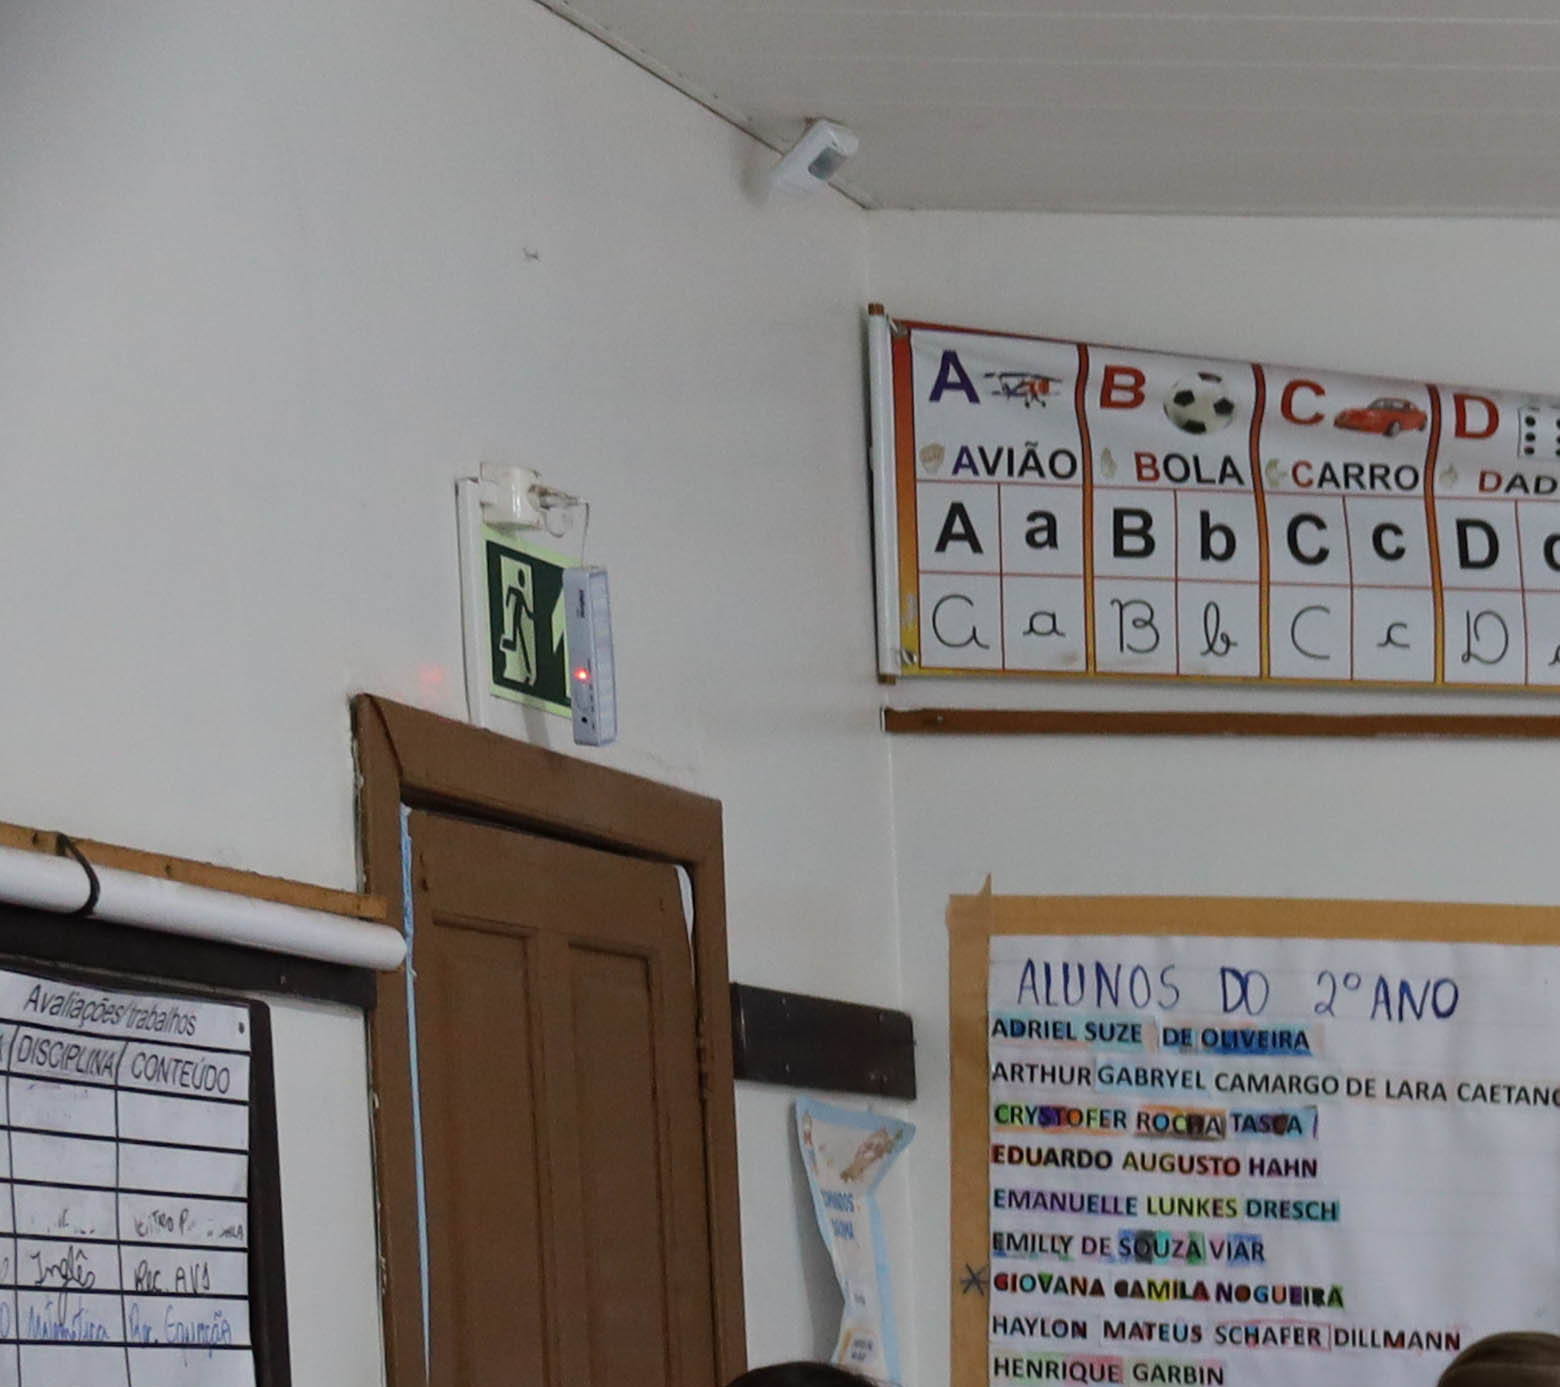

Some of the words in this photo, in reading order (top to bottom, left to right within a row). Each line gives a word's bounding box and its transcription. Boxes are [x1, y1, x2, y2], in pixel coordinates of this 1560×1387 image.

[952, 443, 1077, 479] AVIÃO
[1134, 452, 1244, 486] BOLA
[1292, 460, 1419, 491] CARRO
[1017, 957, 1180, 1010] ALUNOS
[1220, 966, 1269, 1016] DO
[1370, 975, 1459, 1023] ANO
[24, 984, 197, 1037] Avaliações/trabalhos
[991, 1019, 1077, 1042] ADRIEL
[1084, 1021, 1142, 1044] SUZE
[1163, 1026, 1192, 1048] DE
[1201, 1028, 1310, 1051] OLIVEIRA
[17, 1035, 115, 1078] DISCIPLINA
[131, 1051, 230, 1095] CONTEÚDO
[991, 1063, 1091, 1086] ARTHUR
[1097, 1065, 1207, 1090] GABRYEL
[1215, 1073, 1339, 1095] CAMARGO
[1346, 1077, 1376, 1098] DE
[1385, 1079, 1448, 1102] LARA
[994, 1104, 1127, 1130] CRYSTOFER
[1230, 1112, 1302, 1136] TASCA
[991, 1145, 1112, 1169] EDUARDO
[1123, 1151, 1241, 1176] AUGUSTO
[1249, 1158, 1318, 1178] HAHN
[993, 1189, 1137, 1216] EMANUELLE
[1147, 1196, 1238, 1218] LUNKES
[1246, 1199, 1337, 1221] DRESCH
[992, 1232, 1073, 1256] EMILLY
[1081, 1237, 1111, 1256] DE
[1119, 1238, 1202, 1260] SOUZA
[1210, 1241, 1265, 1261] VIAR
[994, 1273, 1105, 1297] GIOVANA
[1216, 1284, 1344, 1309] NOGUEIRA
[993, 1316, 1087, 1340] HAYLON
[1104, 1321, 1202, 1343] MATEUS
[1333, 1327, 1460, 1352] DILLMANN
[994, 1359, 1120, 1384] HENRIQUE
[1133, 1361, 1224, 1386] GARBIN
